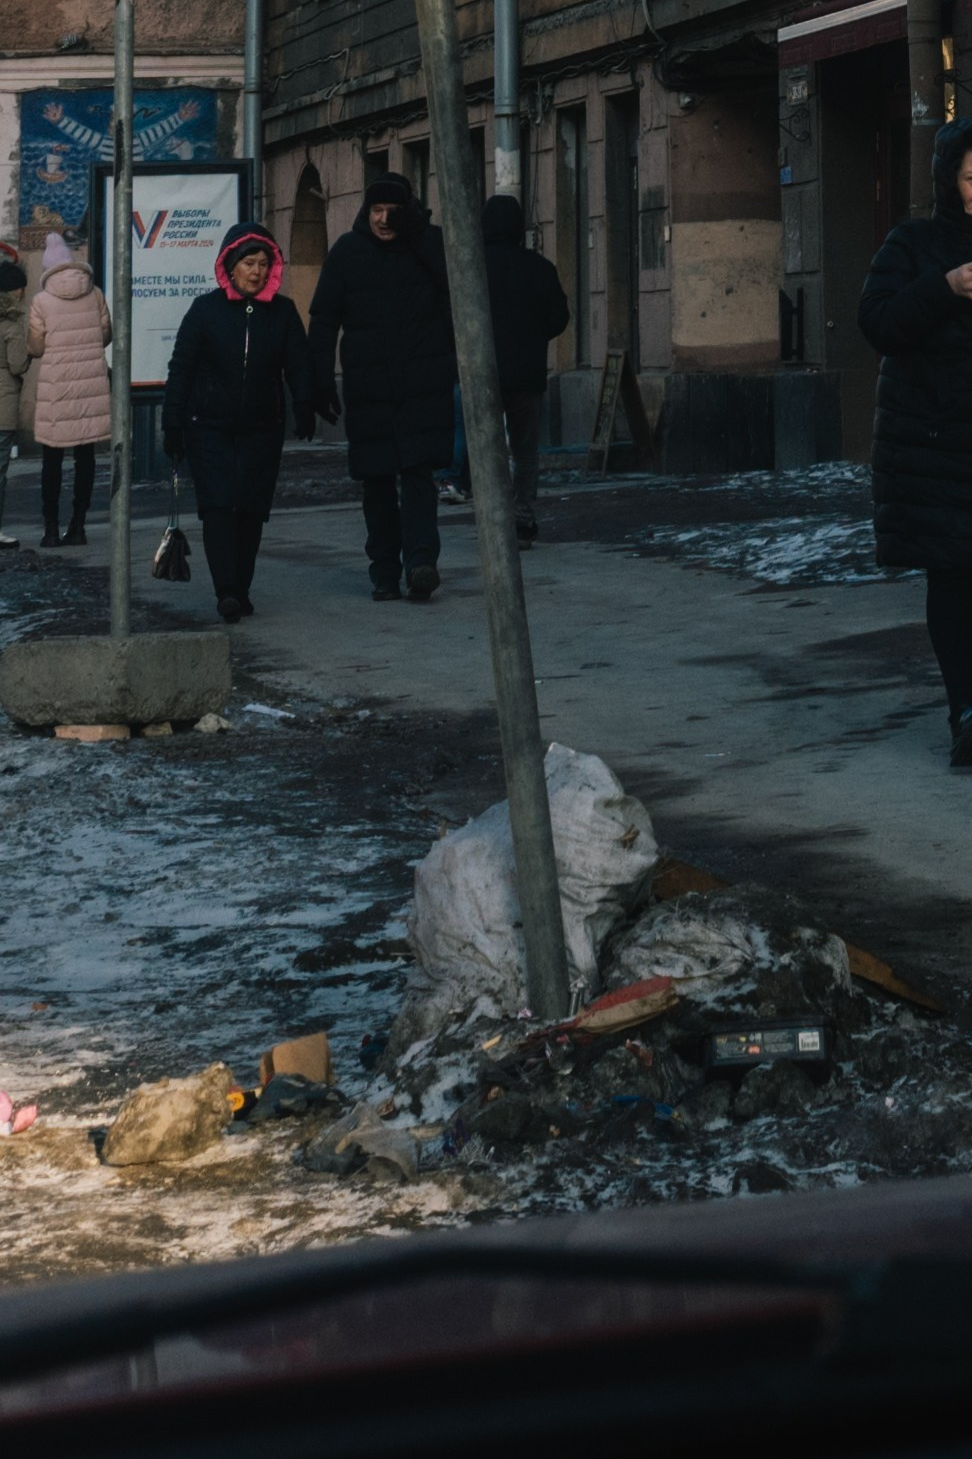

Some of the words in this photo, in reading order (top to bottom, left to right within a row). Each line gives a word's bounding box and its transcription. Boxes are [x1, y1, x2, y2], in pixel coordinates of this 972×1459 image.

[172, 209, 211, 218] ВЫБОРЫ
[167, 219, 222, 229] ПРЕЗИДЕНТА
[162, 230, 198, 239] РОССИИ
[164, 275, 181, 285] МЫ
[183, 274, 206, 285] СИЛА
[169, 288, 180, 297] ЗА
